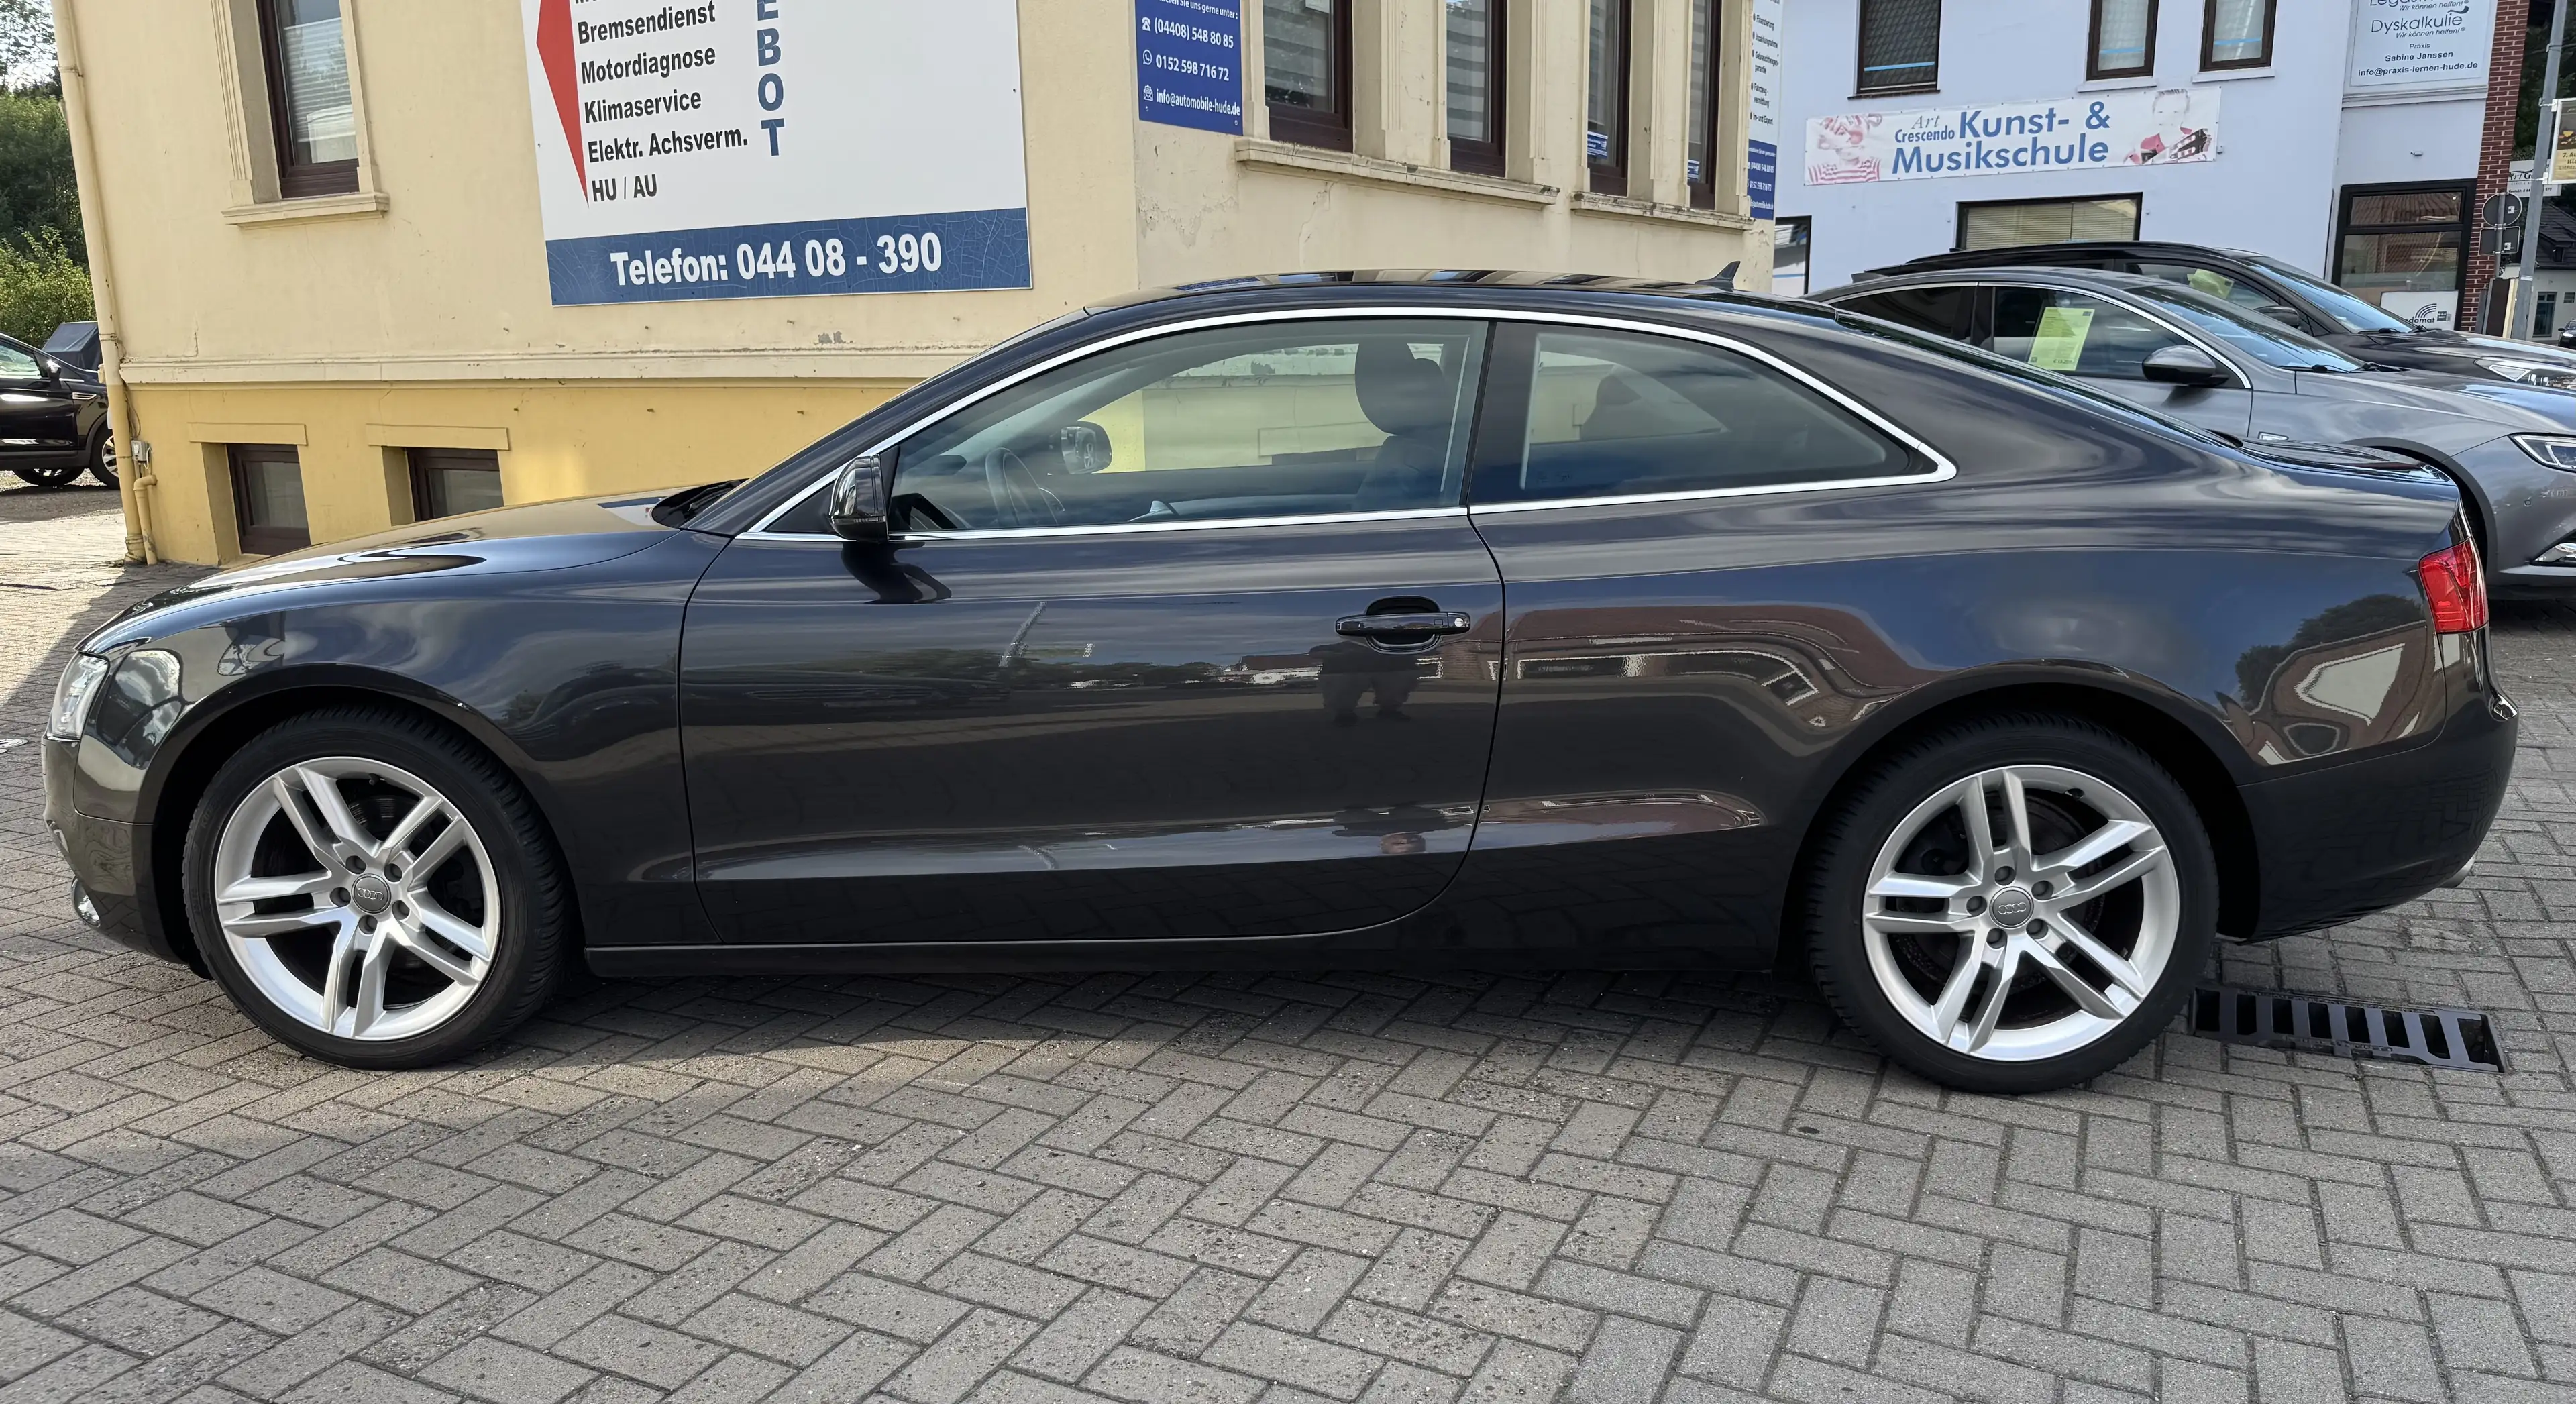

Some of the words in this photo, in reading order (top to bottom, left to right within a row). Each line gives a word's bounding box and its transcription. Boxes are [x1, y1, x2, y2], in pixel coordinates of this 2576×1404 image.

[578, 1, 716, 44] Bremsendienst
[1190, 1, 1201, 11] uns
[1201, 5, 1219, 15] gerne
[1220, 9, 1236, 19] unter
[2371, 13, 2463, 34] Dyskalkulie
[1154, 17, 1190, 41] (04408)
[1191, 27, 1208, 43] 548
[1210, 31, 1222, 46] 80
[1223, 34, 1234, 48] 85
[581, 47, 716, 85] Motordiagnose
[1155, 54, 1179, 72] 0152
[1181, 60, 1199, 75] 598
[1199, 63, 1217, 79] 716
[1218, 67, 1230, 81] 72
[2358, 62, 2478, 76] info@praxis-lernen-hude.de
[2385, 54, 2414, 62] Sabine
[2416, 52, 2454, 60] Janssen
[584, 89, 702, 124] Klimaservice
[1157, 89, 1240, 116] info@automobile-hude.de
[1895, 125, 1955, 143] Crescendo
[1911, 115, 1941, 129] Art
[1959, 107, 2070, 139] Kunst-
[2085, 101, 2110, 130] &
[588, 137, 643, 163] Elektr.
[649, 128, 749, 156] Achsverm.
[1892, 133, 2109, 174] Musikschule
[591, 177, 617, 202] HU
[633, 174, 658, 199] AU
[610, 247, 729, 286] Telefon:
[737, 241, 796, 280] 044
[805, 238, 847, 278] 08
[877, 232, 943, 274] 390
